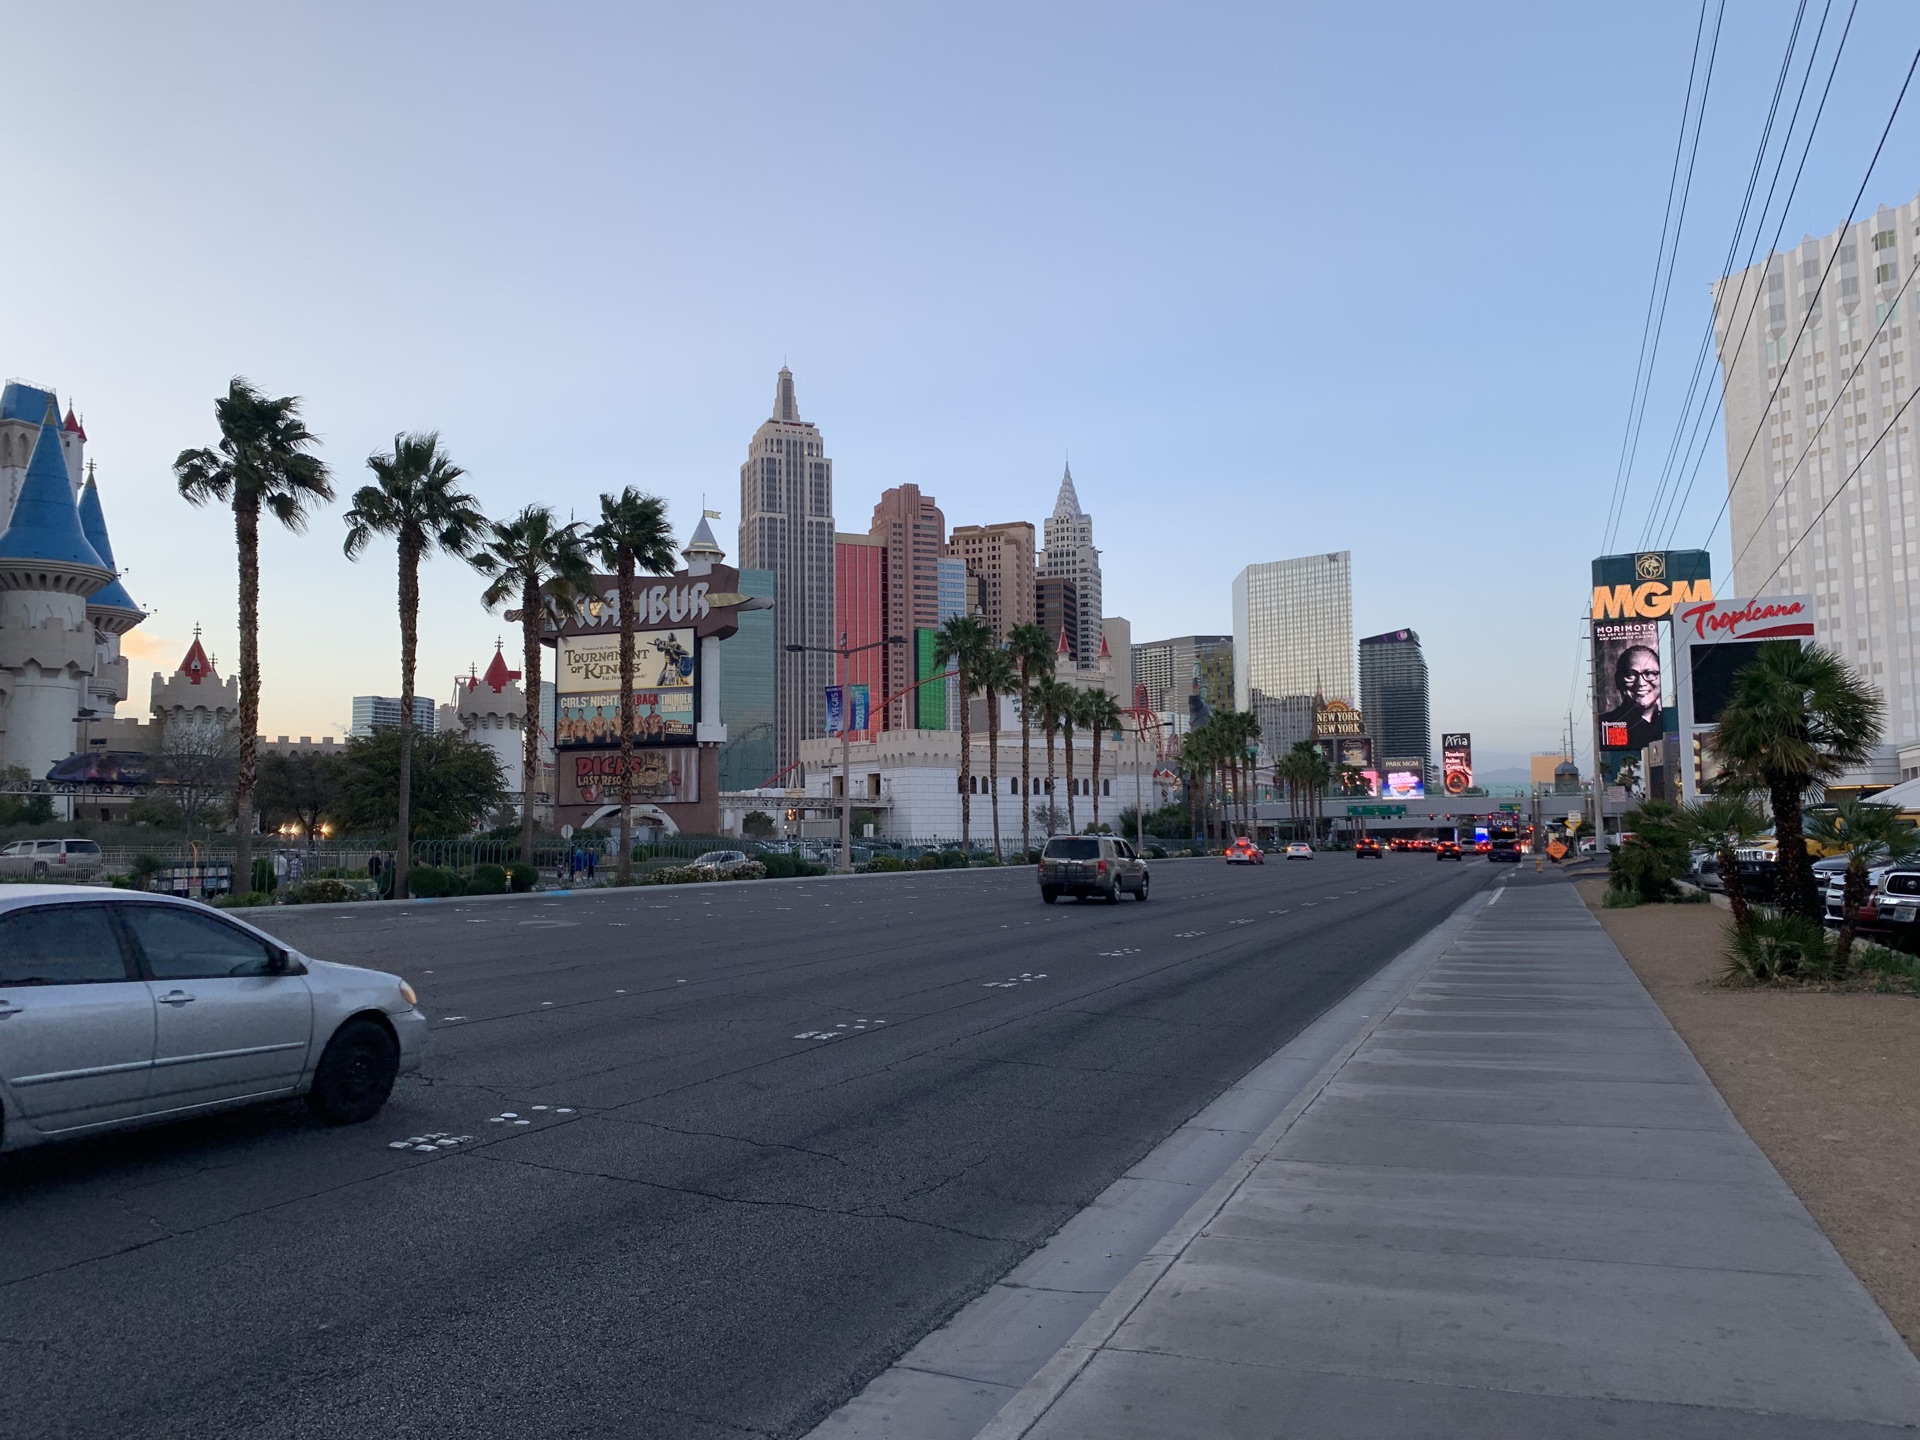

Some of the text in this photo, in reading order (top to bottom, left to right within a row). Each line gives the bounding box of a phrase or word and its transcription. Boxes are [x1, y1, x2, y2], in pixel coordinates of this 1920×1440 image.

[1592, 579, 1713, 620] MGM
[1681, 600, 1805, 640] Tropicana
[1597, 623, 1656, 634] MORIMOTO
[564, 649, 650, 666] TOURNANT
[583, 662, 642, 680] KINS
[560, 696, 589, 708] GIRLS'
[590, 694, 620, 707] NIGHT
[660, 693, 693, 705] THUNDER
[1316, 711, 1361, 722] NEW YORK
[1317, 723, 1361, 734] NEW YORK
[1445, 735, 1468, 747] Aria
[577, 775, 622, 787] LAST RESO
